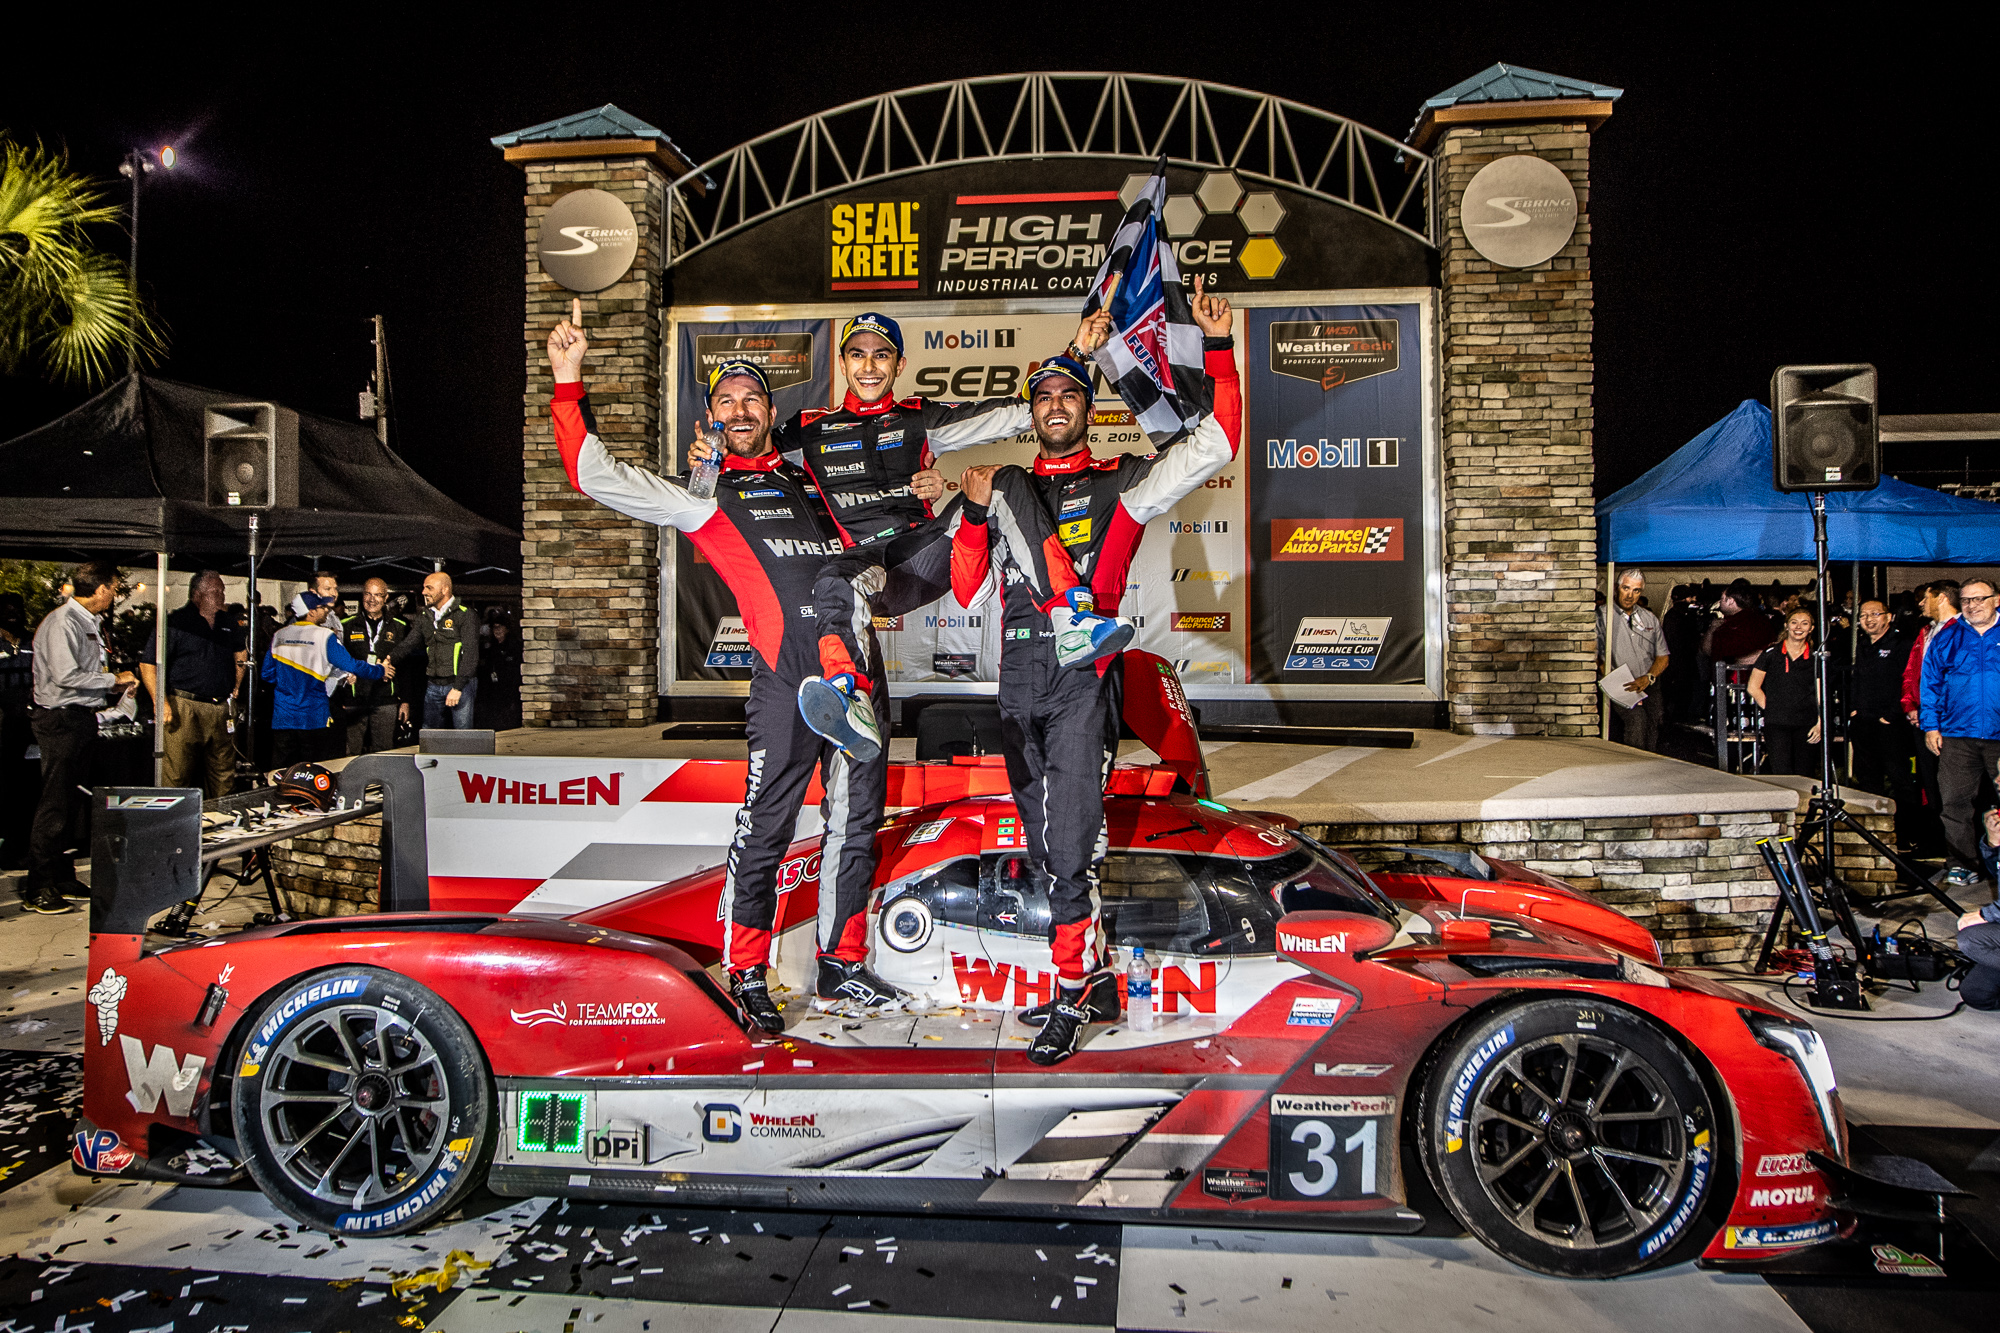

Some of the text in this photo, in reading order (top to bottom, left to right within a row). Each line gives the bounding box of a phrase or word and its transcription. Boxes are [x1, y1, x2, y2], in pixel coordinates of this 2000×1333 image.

[832, 202, 919, 244] SEAL
[947, 213, 1102, 244] HIGH
[542, 226, 634, 255] SEBRING
[831, 243, 919, 277] KRETE
[937, 276, 1096, 293] INDUSTRIAL COAT
[924, 329, 988, 349] Mobil
[1324, 326, 1359, 335] IMSA
[1277, 341, 1392, 353] WeatherTech
[1126, 333, 1162, 391] FUELS
[1107, 432, 1141, 443] 2019
[1267, 438, 1360, 468] Mobil
[1169, 521, 1211, 533] Mobil
[1289, 526, 1363, 542] Advance
[762, 538, 845, 557] WHELE
[1280, 541, 1360, 554] Auto Parts
[1190, 571, 1231, 581] IMSA
[925, 616, 965, 628] Mobil
[716, 643, 752, 652] ENDURA
[1296, 645, 1374, 654] ENDURANCE CUP
[1189, 661, 1232, 672] IMSA
[293, 770, 315, 781] galp
[457, 770, 620, 806] WHELEN
[1279, 931, 1346, 953] WHELEN
[260, 979, 360, 1042] MICHELIN
[584, 1018, 630, 1026] PARKINSON'S
[119, 1034, 207, 1117] W
[1450, 1029, 1509, 1118] MICHELIN
[1277, 1099, 1391, 1112] WeatherTech
[750, 1112, 815, 1127] WHELEN
[750, 1127, 821, 1139] COMMAND
[76, 1128, 121, 1171] VP
[593, 1136, 638, 1159] DPi
[1288, 1119, 1378, 1197] 31
[1758, 1155, 1805, 1175] LUCAS
[1206, 1177, 1266, 1188] WeatherTech
[344, 1172, 448, 1230] MICHELIN
[1750, 1185, 1815, 1207] MOTUL
[1646, 1167, 1706, 1254] MICHELIN
